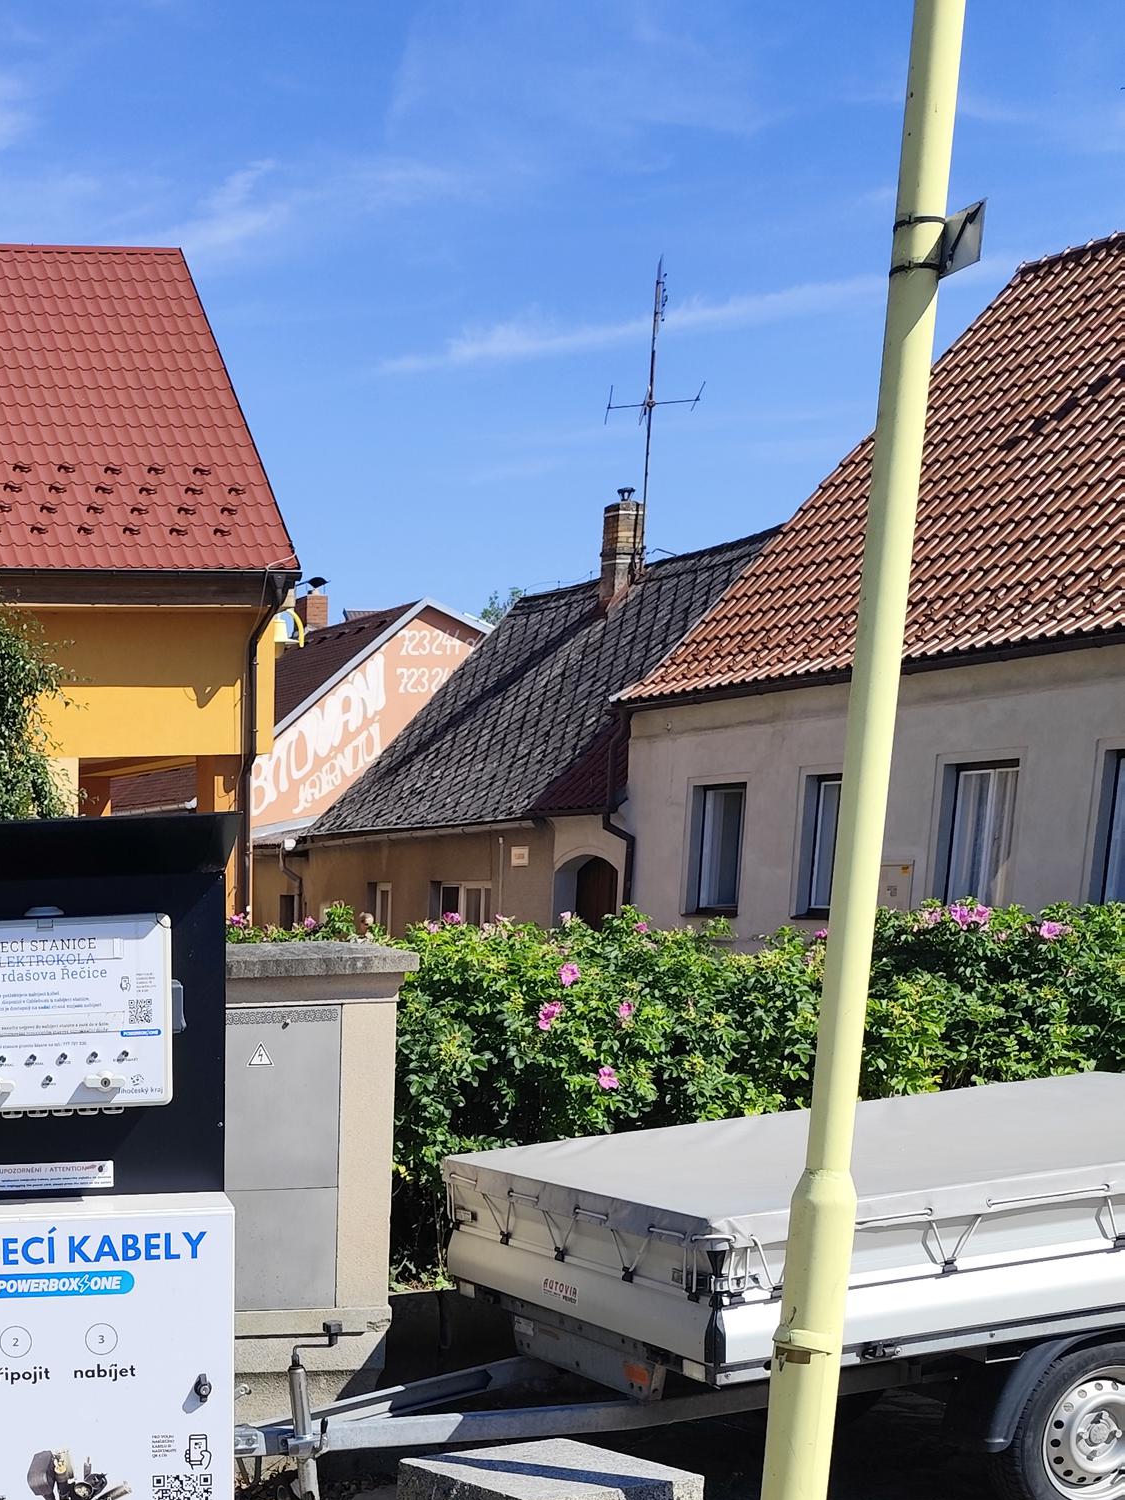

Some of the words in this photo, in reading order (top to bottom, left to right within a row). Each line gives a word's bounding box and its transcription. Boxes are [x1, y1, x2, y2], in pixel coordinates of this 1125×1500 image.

[30, 937, 97, 953] STANICE
[61, 966, 107, 980] Řečice
[68, 1231, 208, 1263] KABELY
[543, 1278, 578, 1299] AUTOVIA
[73, 1363, 136, 1381] nabíjet
